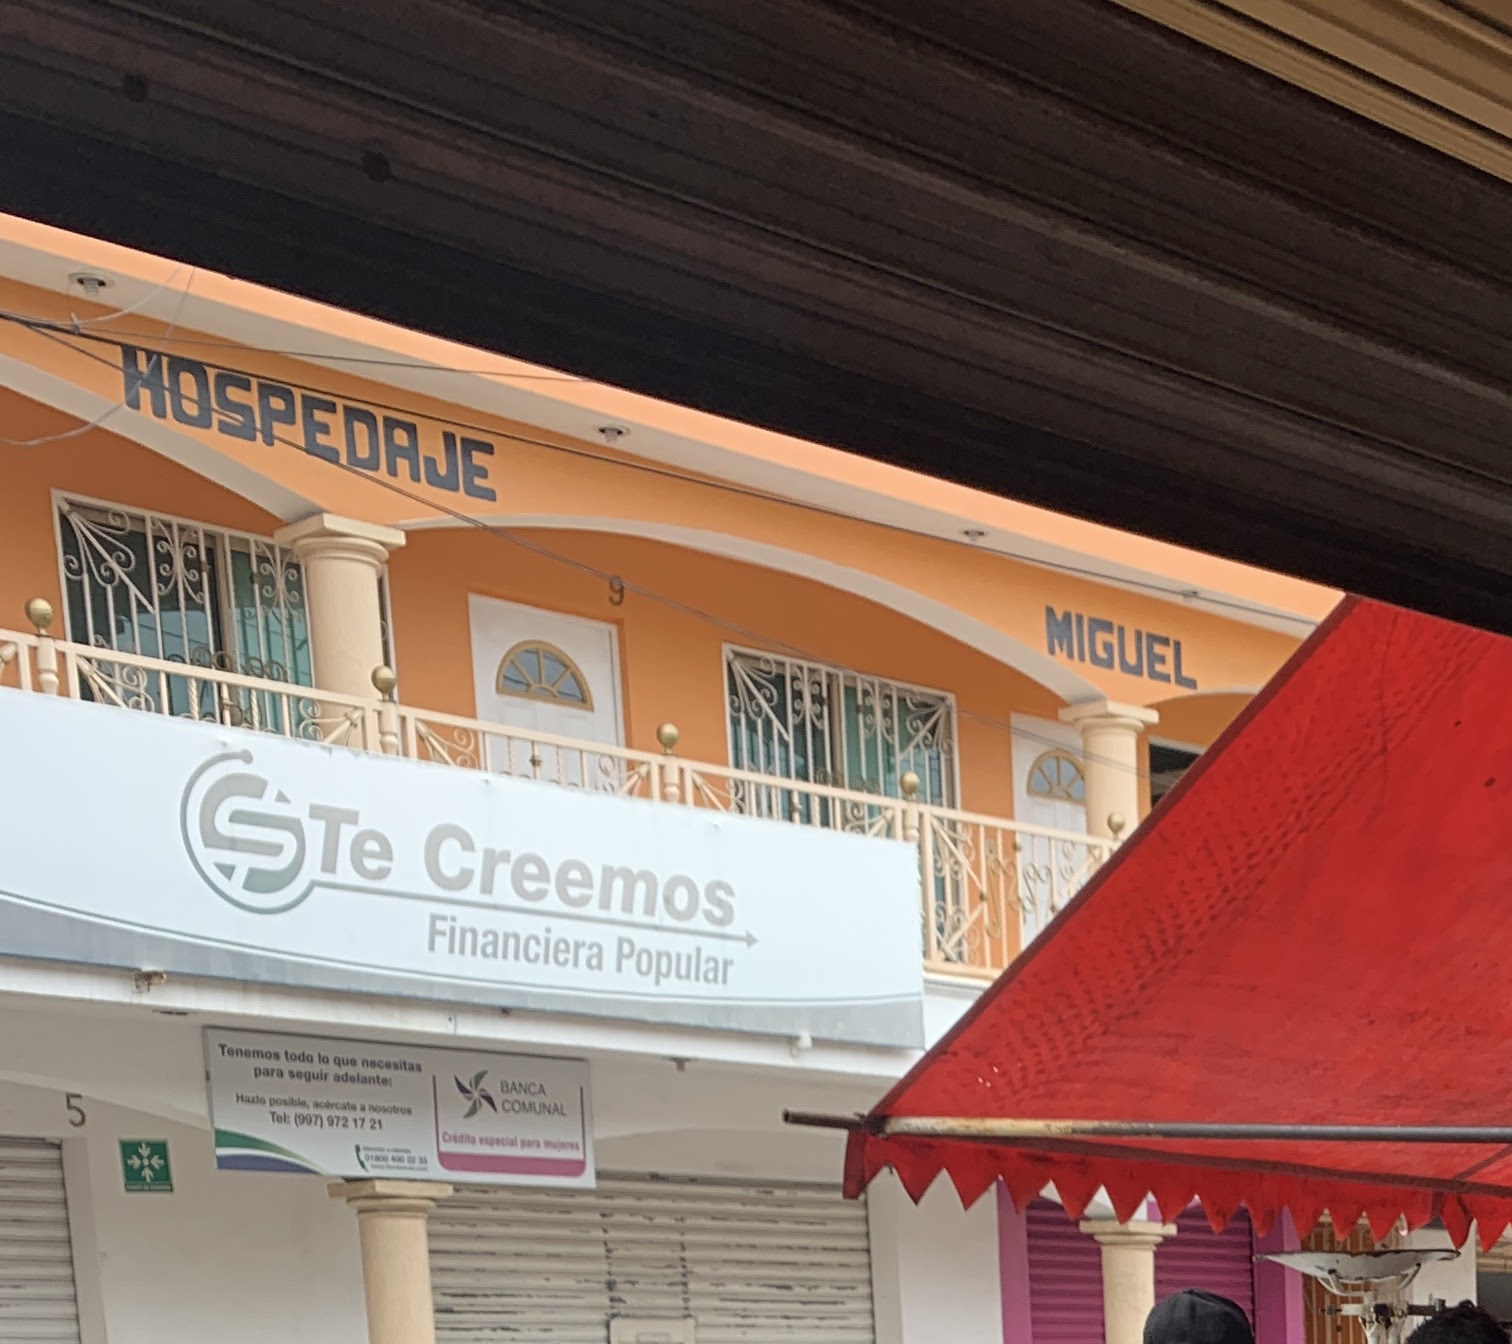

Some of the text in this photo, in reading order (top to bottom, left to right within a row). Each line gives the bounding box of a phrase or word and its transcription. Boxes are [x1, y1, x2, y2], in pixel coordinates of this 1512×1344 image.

[121, 345, 497, 501] HOSPEDAJE
[608, 575, 625, 606] 9
[1045, 605, 1198, 690] MIGUEL
[308, 803, 735, 927] Te Creemos
[427, 912, 735, 986] Financiera Popular
[218, 1043, 422, 1072] Tenemos todo lo que necesitas
[253, 1067, 284, 1079] para
[288, 1069, 329, 1082] seguir
[501, 1079, 546, 1096] BANCA
[65, 1093, 86, 1127] 5
[235, 1092, 266, 1105] Hazlo
[502, 1099, 567, 1117] COMUNAL
